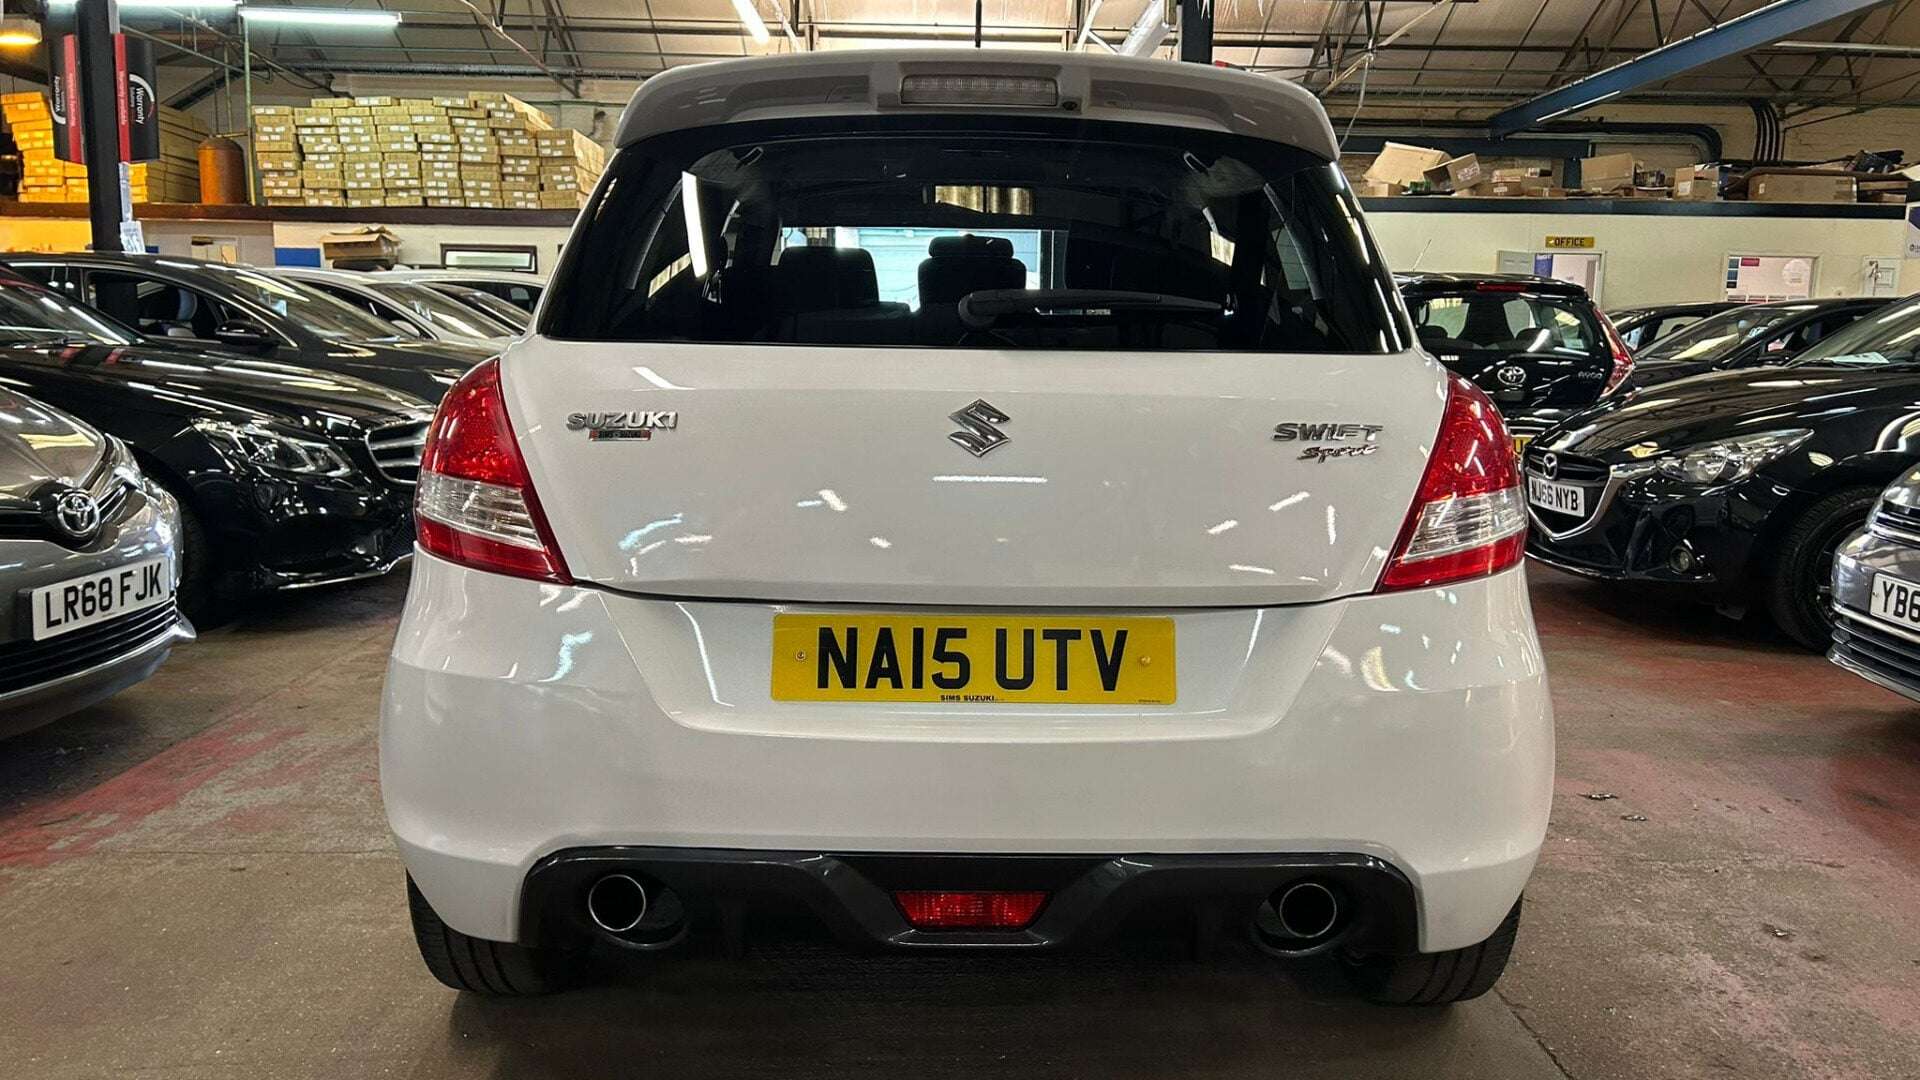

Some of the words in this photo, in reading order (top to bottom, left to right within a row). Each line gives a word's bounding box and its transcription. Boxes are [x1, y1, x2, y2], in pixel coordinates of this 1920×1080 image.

[135, 87, 145, 124] Warranty
[1554, 236, 1585, 247] OFFICE
[566, 411, 678, 430] SUZUKI
[1273, 423, 1383, 441] SWIFT
[1297, 444, 1379, 464] Sport
[1531, 480, 1553, 505] NJ66
[1555, 486, 1578, 511] NYB
[45, 577, 113, 629] LR68
[120, 562, 162, 606] FJK
[817, 627, 971, 690] NA15
[995, 628, 1129, 692] UTV
